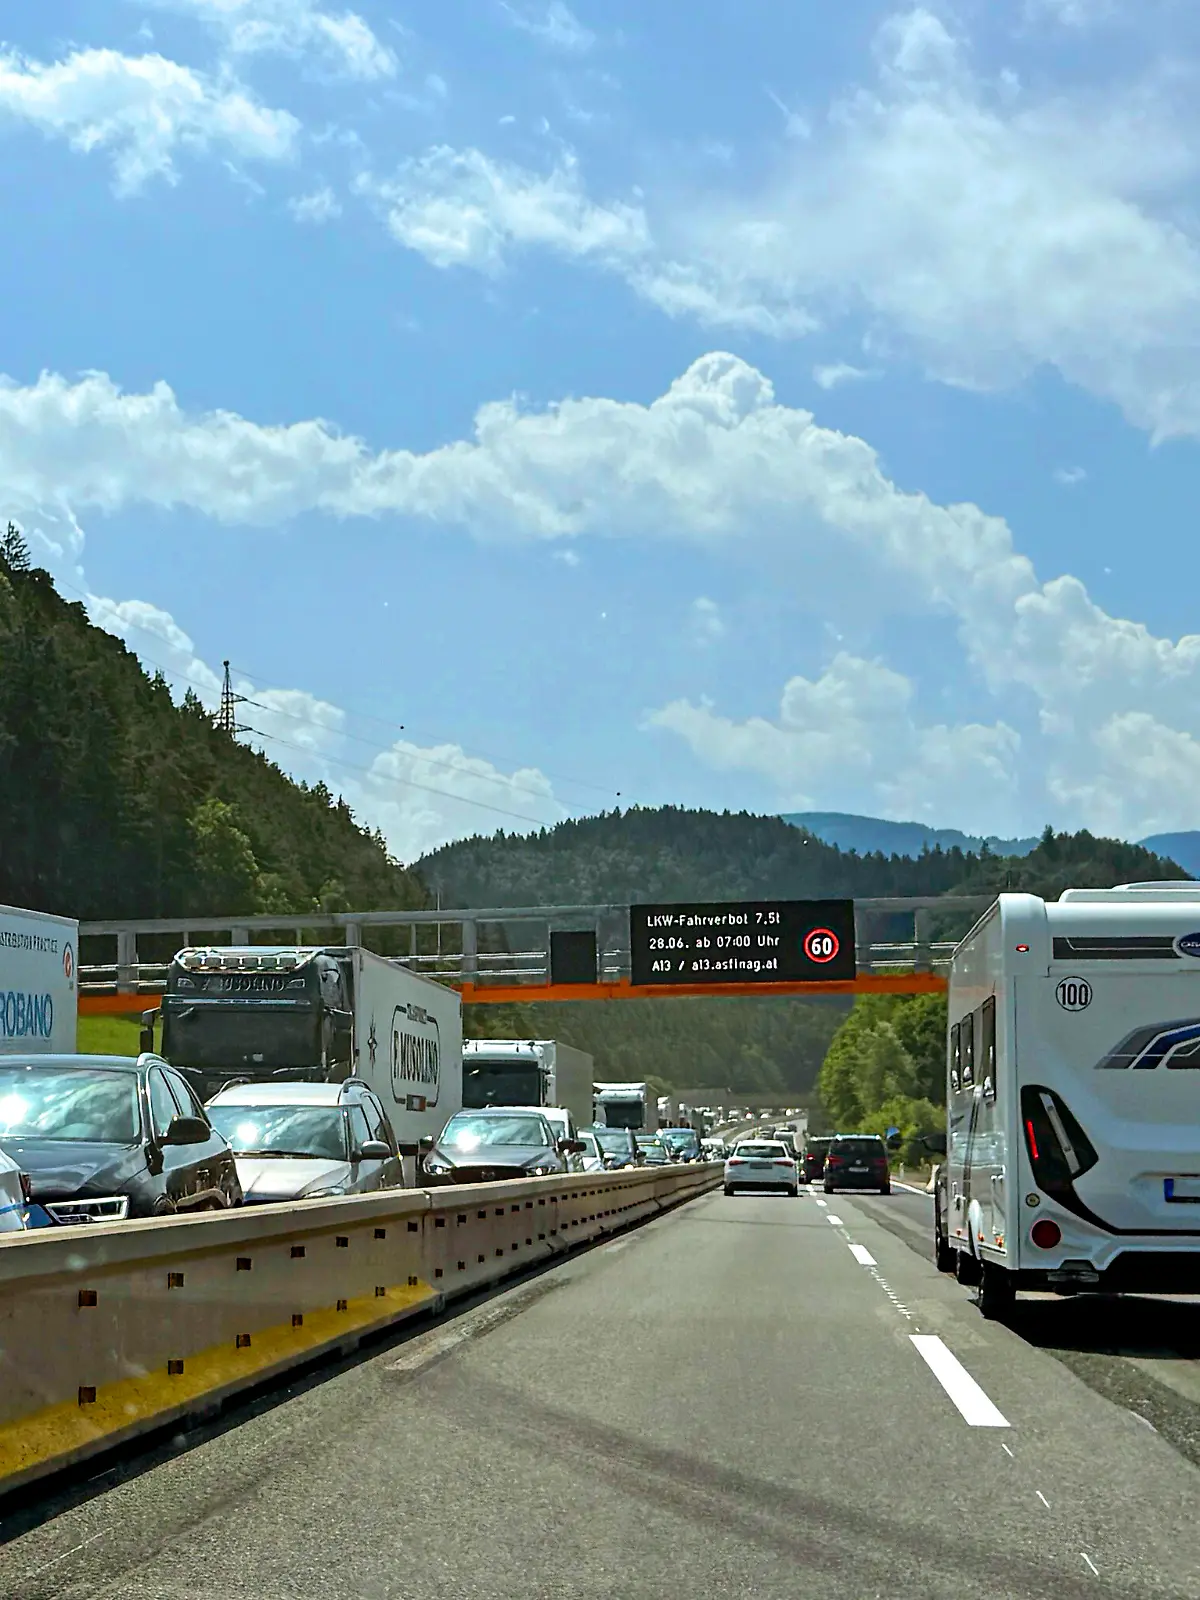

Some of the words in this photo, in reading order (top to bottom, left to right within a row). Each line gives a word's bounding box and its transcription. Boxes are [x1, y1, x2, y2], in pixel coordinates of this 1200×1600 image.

[647, 913, 748, 927] LKW-Fahrverbot
[755, 911, 780, 925] 7.5t
[649, 937, 690, 950] 28.06.
[696, 936, 711, 948] ab
[717, 935, 751, 948] 07:00
[757, 934, 780, 947] Uhr
[811, 937, 833, 955] 60
[652, 959, 672, 972] A13
[678, 959, 685, 971] /
[692, 957, 778, 973] a13.asfinag.at
[1059, 983, 1089, 1006] 100
